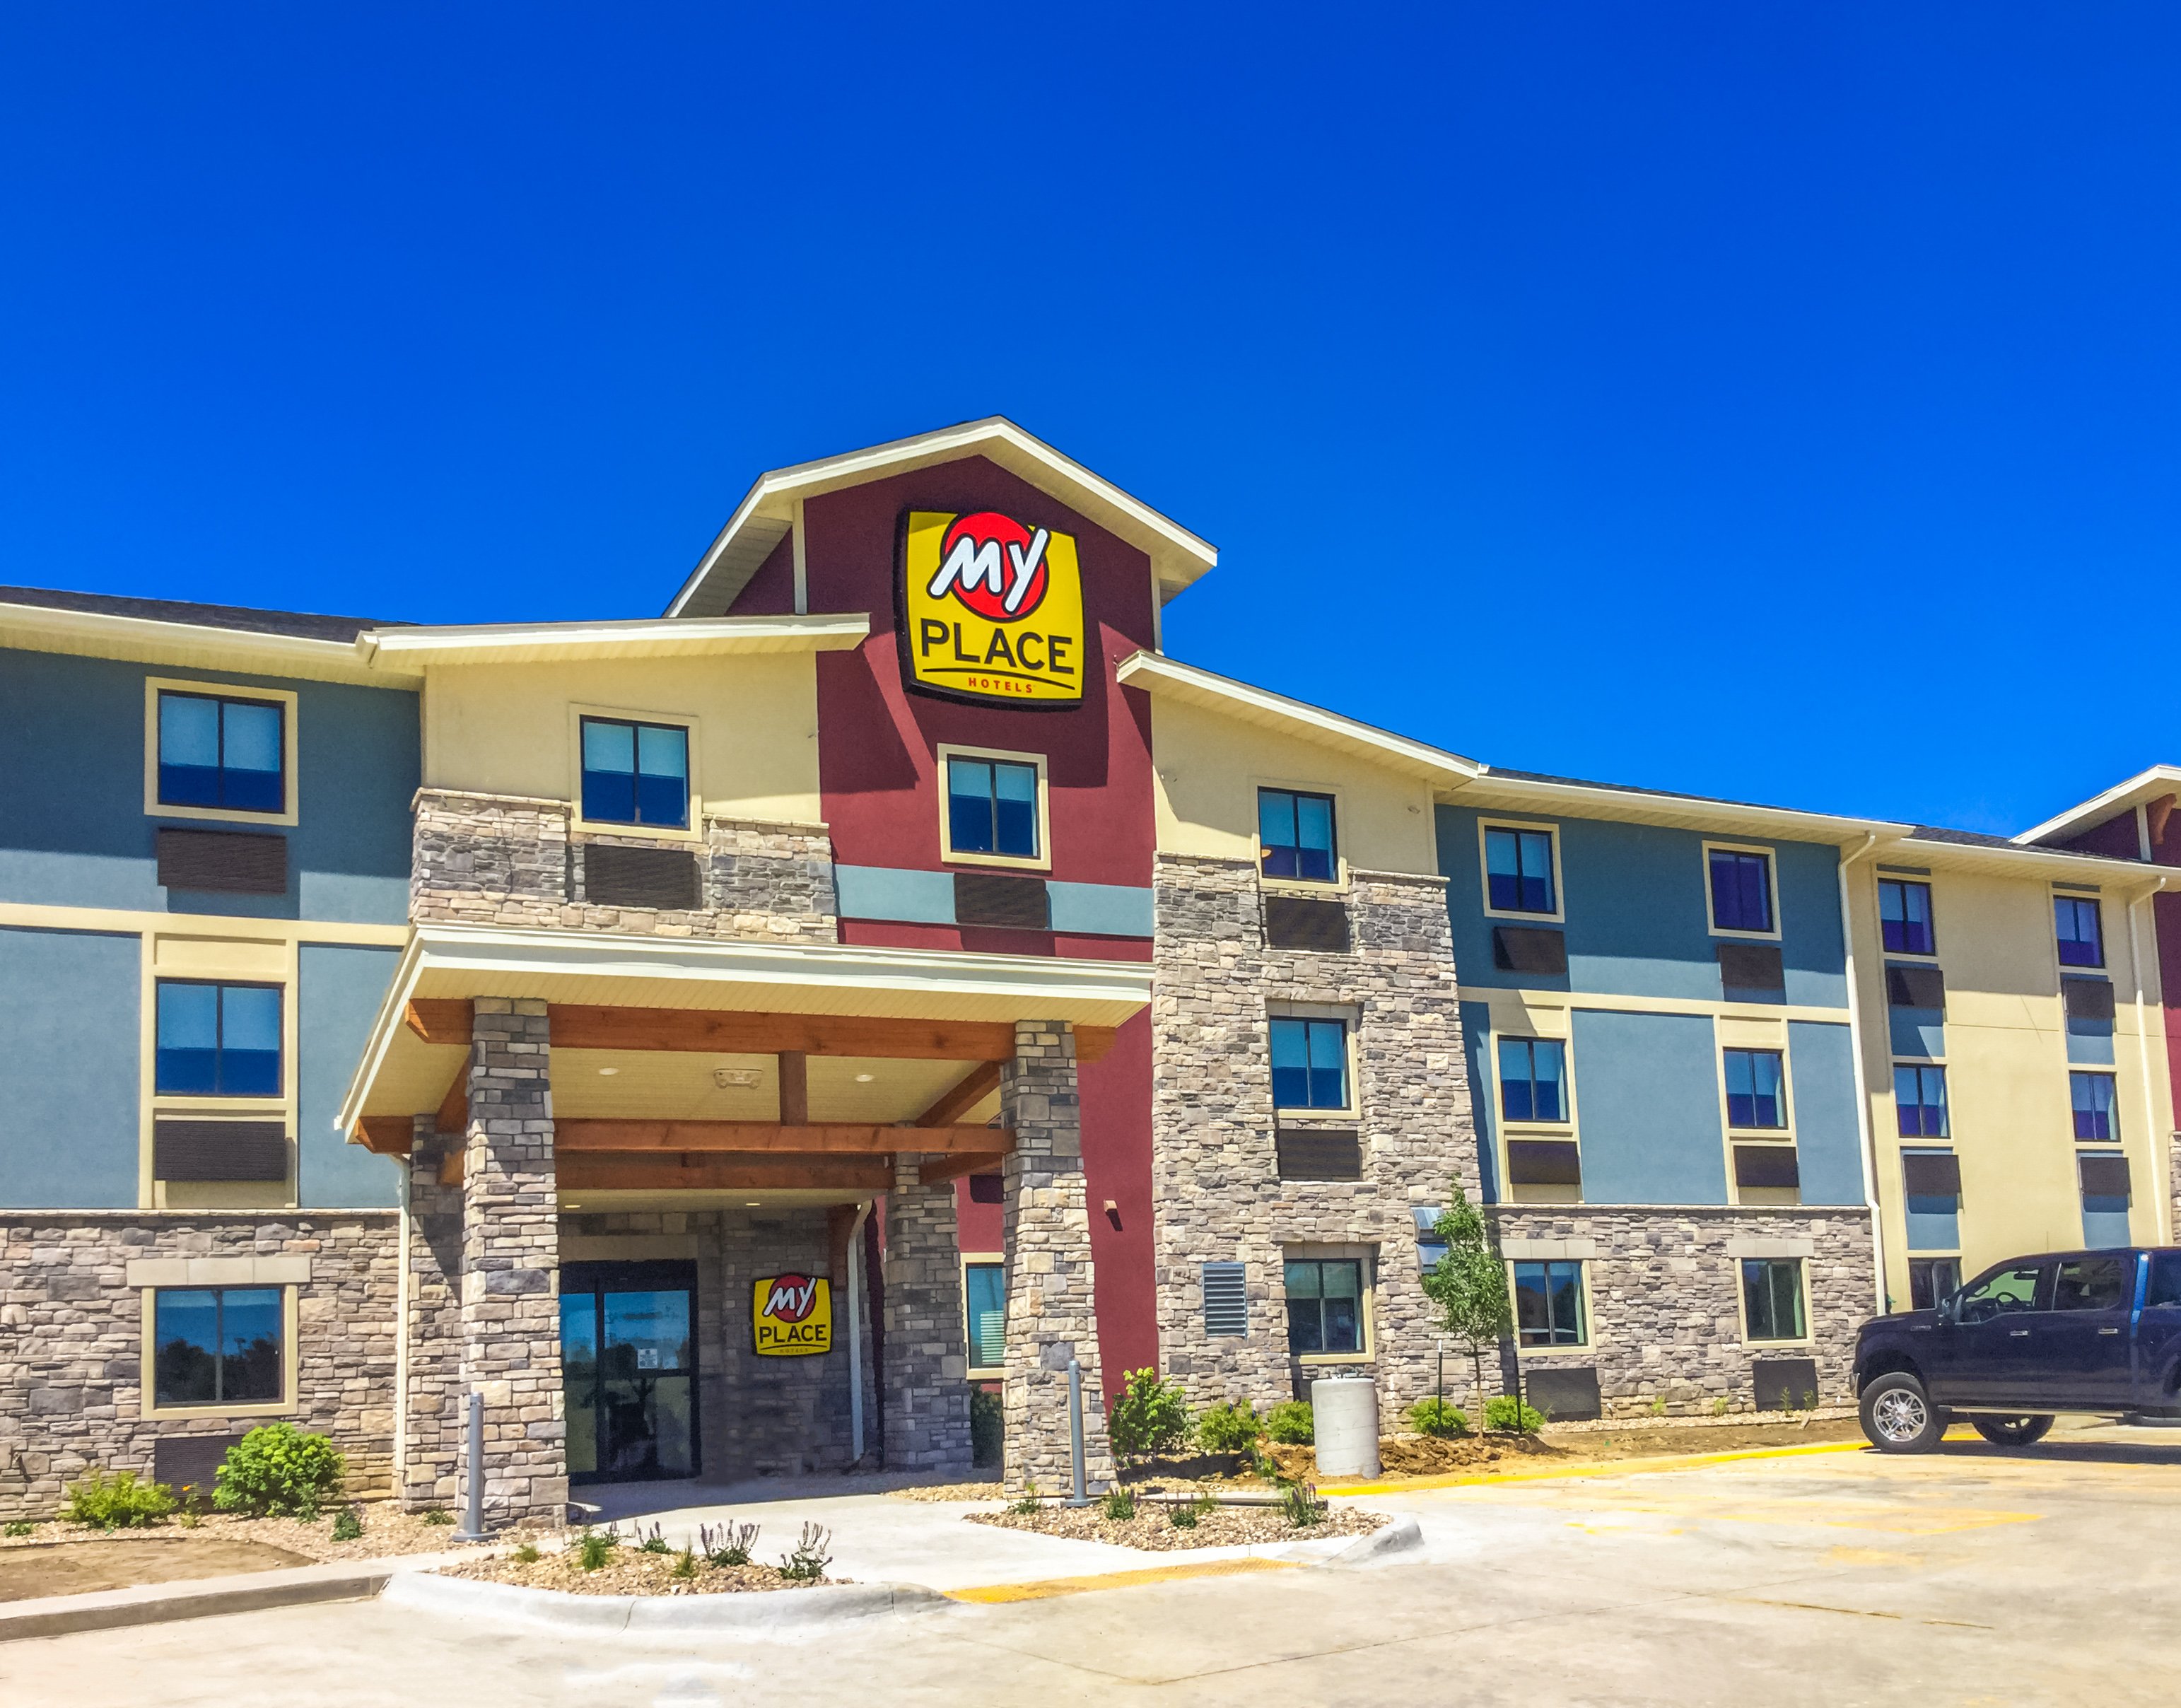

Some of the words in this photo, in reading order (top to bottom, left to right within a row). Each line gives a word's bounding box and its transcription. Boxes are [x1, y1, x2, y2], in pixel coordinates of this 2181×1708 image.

[920, 617, 1075, 675] PLACE
[968, 677, 1033, 694] HOTELS
[759, 1323, 827, 1344] PLACE
